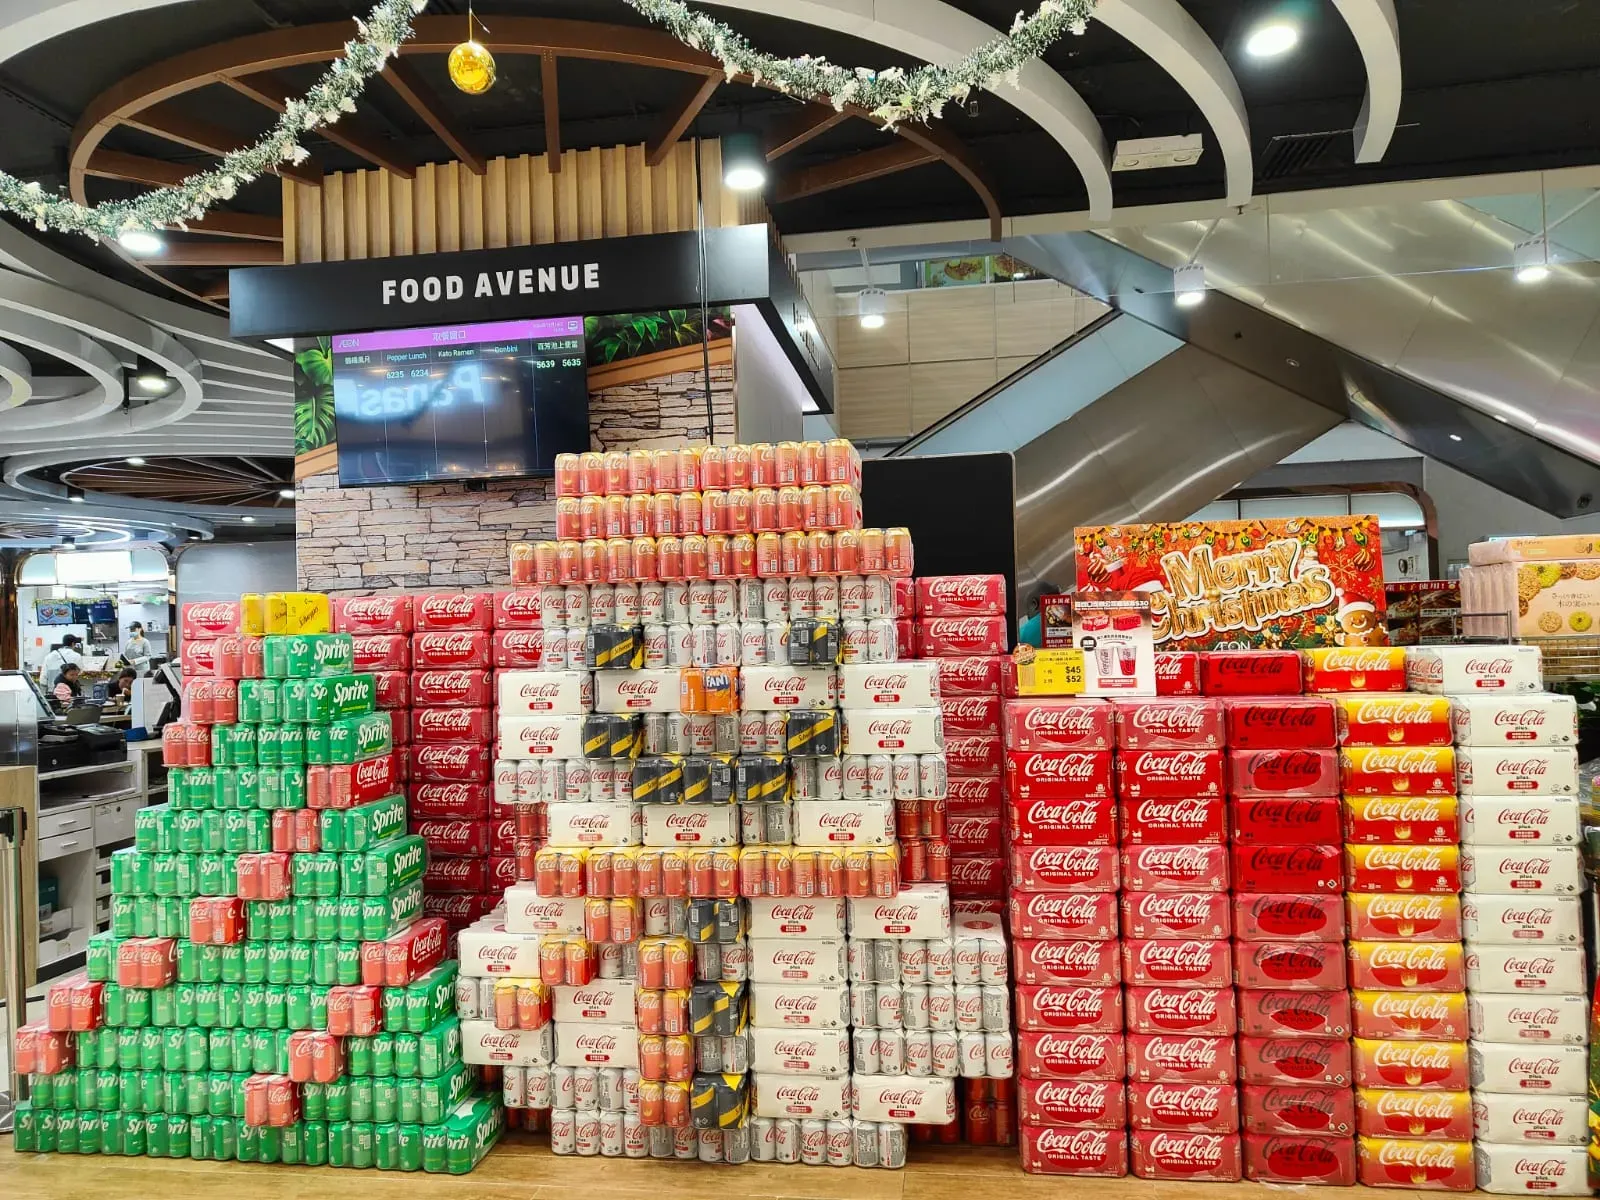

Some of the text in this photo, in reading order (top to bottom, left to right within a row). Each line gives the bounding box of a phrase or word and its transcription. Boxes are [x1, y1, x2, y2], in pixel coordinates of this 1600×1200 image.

[383, 263, 599, 304] FOOD AVENUE
[387, 352, 426, 362] Pepper Lunch
[1162, 541, 1299, 601] Merry
[929, 576, 992, 597] Coca-Cola
[422, 594, 476, 614] Coca-Cola
[930, 616, 992, 637] Coca-Cola
[314, 638, 350, 664] Sprite
[420, 632, 475, 652] Coca-Cola
[1066, 666, 1081, 674] $45
[1323, 650, 1391, 671] Coca-Cola
[1466, 658, 1514, 674] Coca-Cola
[420, 671, 473, 689] Coca-Cola
[618, 680, 658, 694] Coca-Cola
[765, 676, 808, 691] Coca-Cola
[865, 675, 908, 689] Coca-Cola
[1066, 675, 1081, 683] $52
[333, 680, 368, 706] Sprite
[520, 684, 560, 697] Coca-Cola
[420, 708, 472, 727] Coca-Cola
[1025, 707, 1098, 730] Coca-Cola
[1134, 704, 1208, 728] Coca-Cola
[1357, 700, 1435, 724] Coca-Cola
[1494, 709, 1548, 726] Coca-Cola
[358, 720, 388, 746] Sprite
[520, 727, 561, 741] Coca-Cola
[869, 720, 913, 735] Coca-Cola
[1025, 753, 1098, 777] Coca-Cola
[1135, 752, 1209, 776] Coca-Cola
[1362, 747, 1439, 773] Coca-Cola
[1496, 759, 1550, 775] Coca-Cola
[417, 784, 472, 802] Coca-Cola
[372, 804, 404, 832] Sprite
[666, 813, 709, 827] Coca-Cola
[1028, 800, 1100, 824] Coca-Cola
[1137, 799, 1212, 823] Coca-Cola
[1363, 797, 1443, 822] Coca-Cola
[1498, 809, 1550, 825] Coca-Cola
[569, 815, 610, 829] Coca-Cola
[819, 813, 863, 828] Coca-Cola
[393, 846, 422, 876] Sprite
[1030, 847, 1101, 871] Coca-Cola
[1138, 845, 1211, 870] Coca-Cola
[1365, 845, 1444, 871] Coca-Cola
[1500, 858, 1552, 874] Coca-Cola
[390, 890, 421, 921] Sprite
[525, 903, 565, 917] Coca-Cola
[772, 904, 815, 920] Coca-Cola
[874, 904, 919, 920] Coca-Cola
[1028, 894, 1100, 918] Coca-Cola
[1140, 893, 1213, 917] Coca-Cola
[1366, 895, 1446, 920] Coca-Cola
[1502, 908, 1554, 924] Coca-Cola
[479, 946, 519, 960] Coca-Cola
[773, 950, 816, 965] Coca-Cola
[1031, 941, 1103, 965] Coca-Cola
[1140, 941, 1214, 965] Coca-Cola
[1369, 944, 1450, 970] Coca-Cola
[1504, 957, 1556, 974] Coca-Cola
[435, 975, 455, 1008] Spri
[573, 991, 614, 1007] Coca-Cola
[1033, 987, 1105, 1012] Coca-Cola
[1144, 989, 1218, 1013] Coca-Cola
[775, 995, 819, 1010] Coca-Cola
[1372, 992, 1452, 1019] Coca-Cola
[1508, 1008, 1560, 1024] Coca-Cola
[480, 1033, 521, 1048] Coca-Cola
[576, 1035, 617, 1049] Coca-Cola
[775, 1041, 819, 1056] Coca-Cola
[1035, 1034, 1107, 1059] Coca-Cola
[1145, 1037, 1218, 1062] Coca-Cola
[1374, 1042, 1455, 1068] Coca-Cola
[1509, 1058, 1562, 1075] Coca-Cola
[777, 1086, 820, 1100] Coca-Cola
[879, 1089, 924, 1105] Coca-Cola
[1035, 1082, 1108, 1107] Coca-Cola
[1146, 1084, 1220, 1111] Coca-Cola
[1376, 1090, 1458, 1118] Coca-Cola
[1513, 1108, 1565, 1125] Coca-Cola
[1037, 1129, 1109, 1155] Coca-Cola
[1150, 1133, 1224, 1159] Coca-Cola
[1380, 1140, 1460, 1168] Coca-Cola
[1515, 1158, 1567, 1176] Coca-Cola
